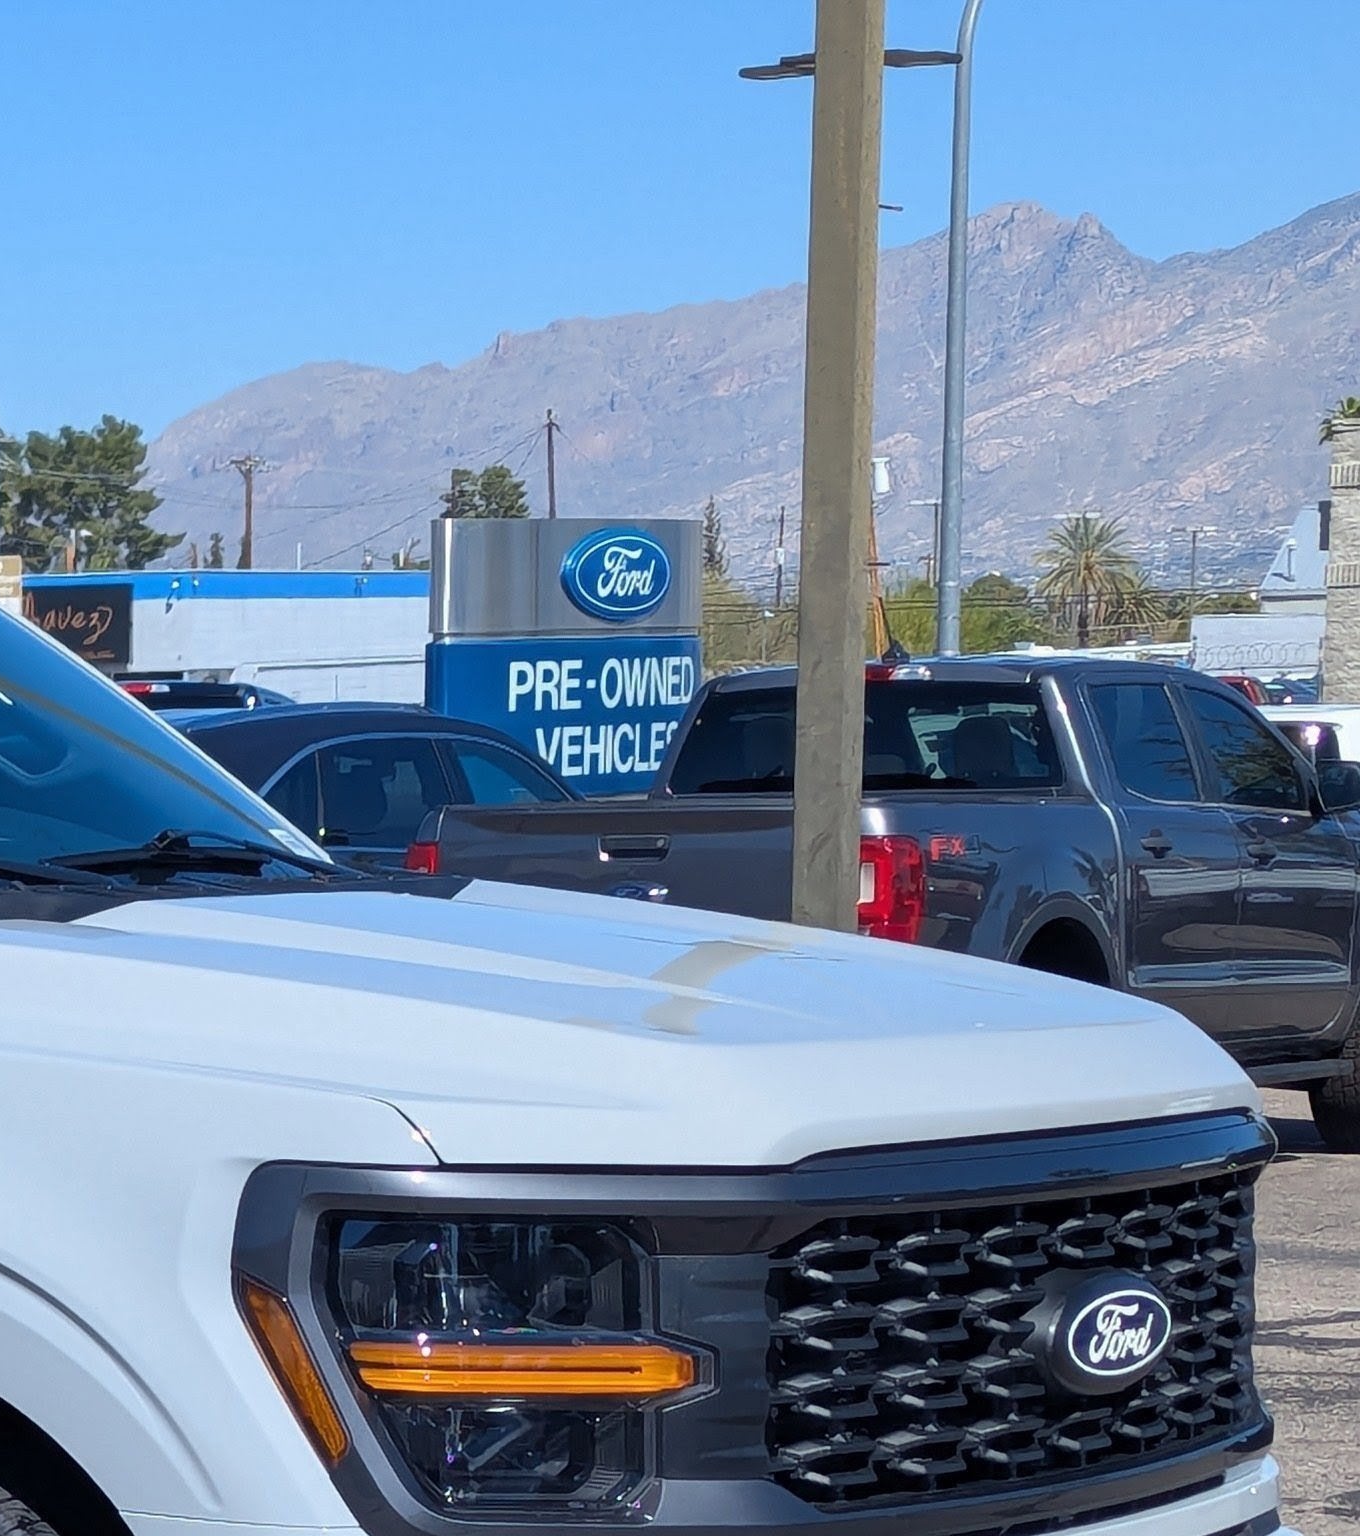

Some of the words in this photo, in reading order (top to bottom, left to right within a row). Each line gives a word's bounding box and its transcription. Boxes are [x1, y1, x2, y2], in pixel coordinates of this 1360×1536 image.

[596, 545, 657, 599] Ford
[507, 656, 695, 712] PRE-OWNED
[1088, 1302, 1154, 1364] Ford
